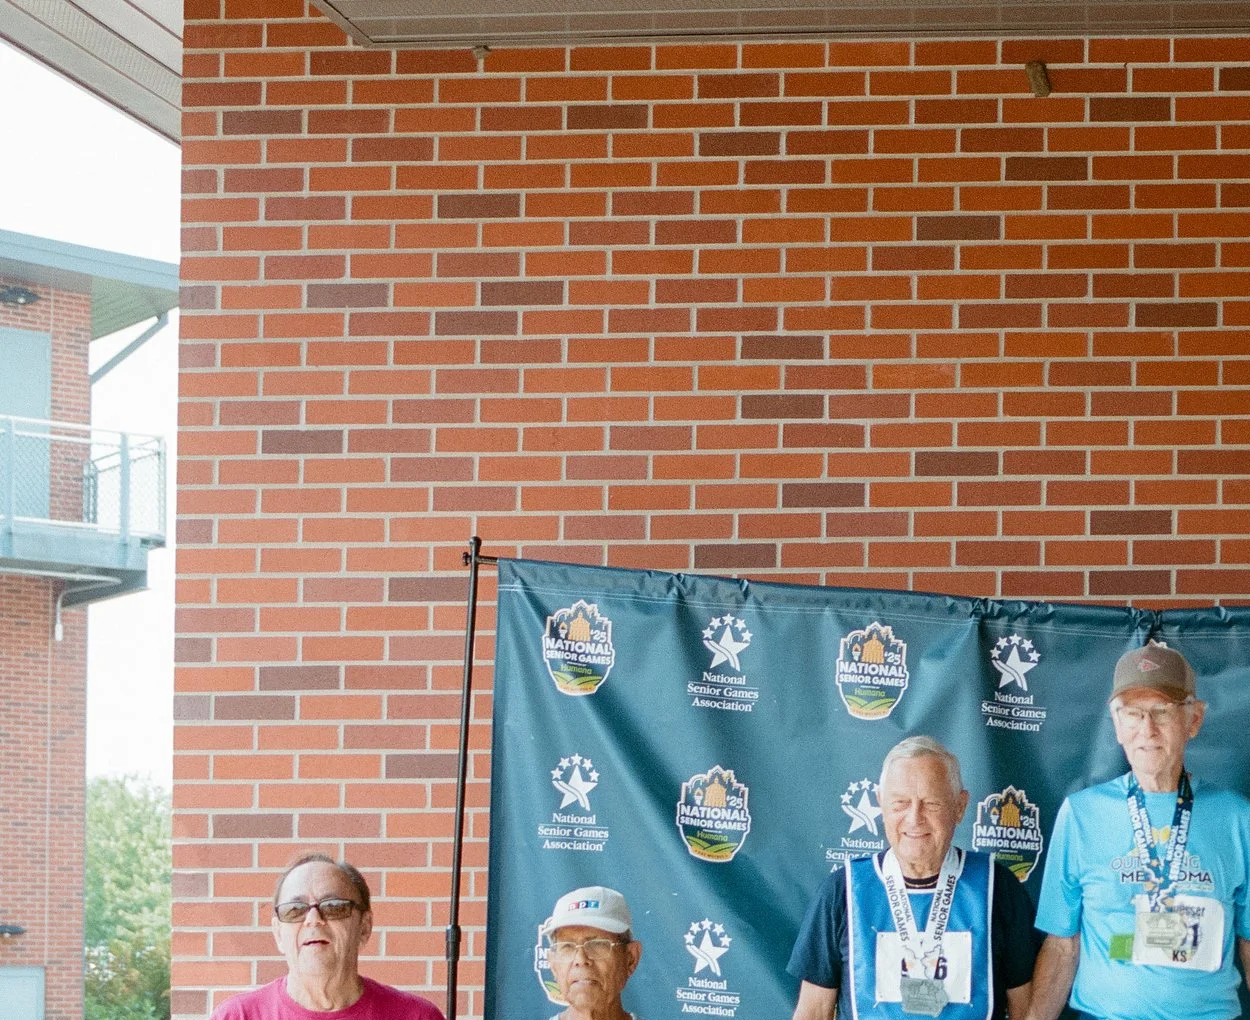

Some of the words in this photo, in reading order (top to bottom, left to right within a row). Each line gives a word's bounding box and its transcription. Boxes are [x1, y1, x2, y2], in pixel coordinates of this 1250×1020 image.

[591, 629, 606, 642] '25
[546, 637, 611, 656] NATIONAL
[546, 651, 577, 662] SENIOR
[578, 654, 611, 666] GAMES
[884, 651, 901, 664] '25
[839, 661, 904, 678] NATIONAL
[702, 672, 746, 684] National
[839, 674, 871, 684] SENIOR
[872, 676, 904, 687] GAMES
[688, 683, 721, 697] Senior
[723, 686, 758, 700] Games
[994, 691, 1033, 704] National
[692, 698, 752, 711] Association
[981, 702, 1012, 716] Senior
[1014, 706, 1046, 719] Games
[986, 717, 1041, 731] Association
[726, 796, 742, 809] '25
[552, 813, 596, 824] National
[681, 804, 749, 822] NATIONAL
[680, 816, 712, 828] SENIOR
[714, 819, 748, 831] GAMES
[1020, 816, 1035, 829] '25
[1176, 809, 1190, 844] GAMES
[538, 826, 572, 837] Senior
[574, 828, 609, 839] Games
[977, 825, 1040, 841] NATIONAL
[543, 839, 602, 851] Association
[841, 837, 884, 849] National
[976, 838, 1008, 848] SENIOR
[1010, 839, 1039, 851] GAMES
[886, 875, 900, 907] SENIOR
[894, 907, 910, 942] GAMES
[899, 888, 912, 922] NATIONAL
[932, 890, 943, 922] NATIONAL
[934, 908, 948, 940] SENIOR
[944, 874, 956, 908] GAMES
[1172, 951, 1186, 962] KS
[688, 977, 726, 990] National
[676, 989, 706, 1001] Senior
[708, 992, 739, 1004] Games
[682, 1003, 734, 1017] Association
